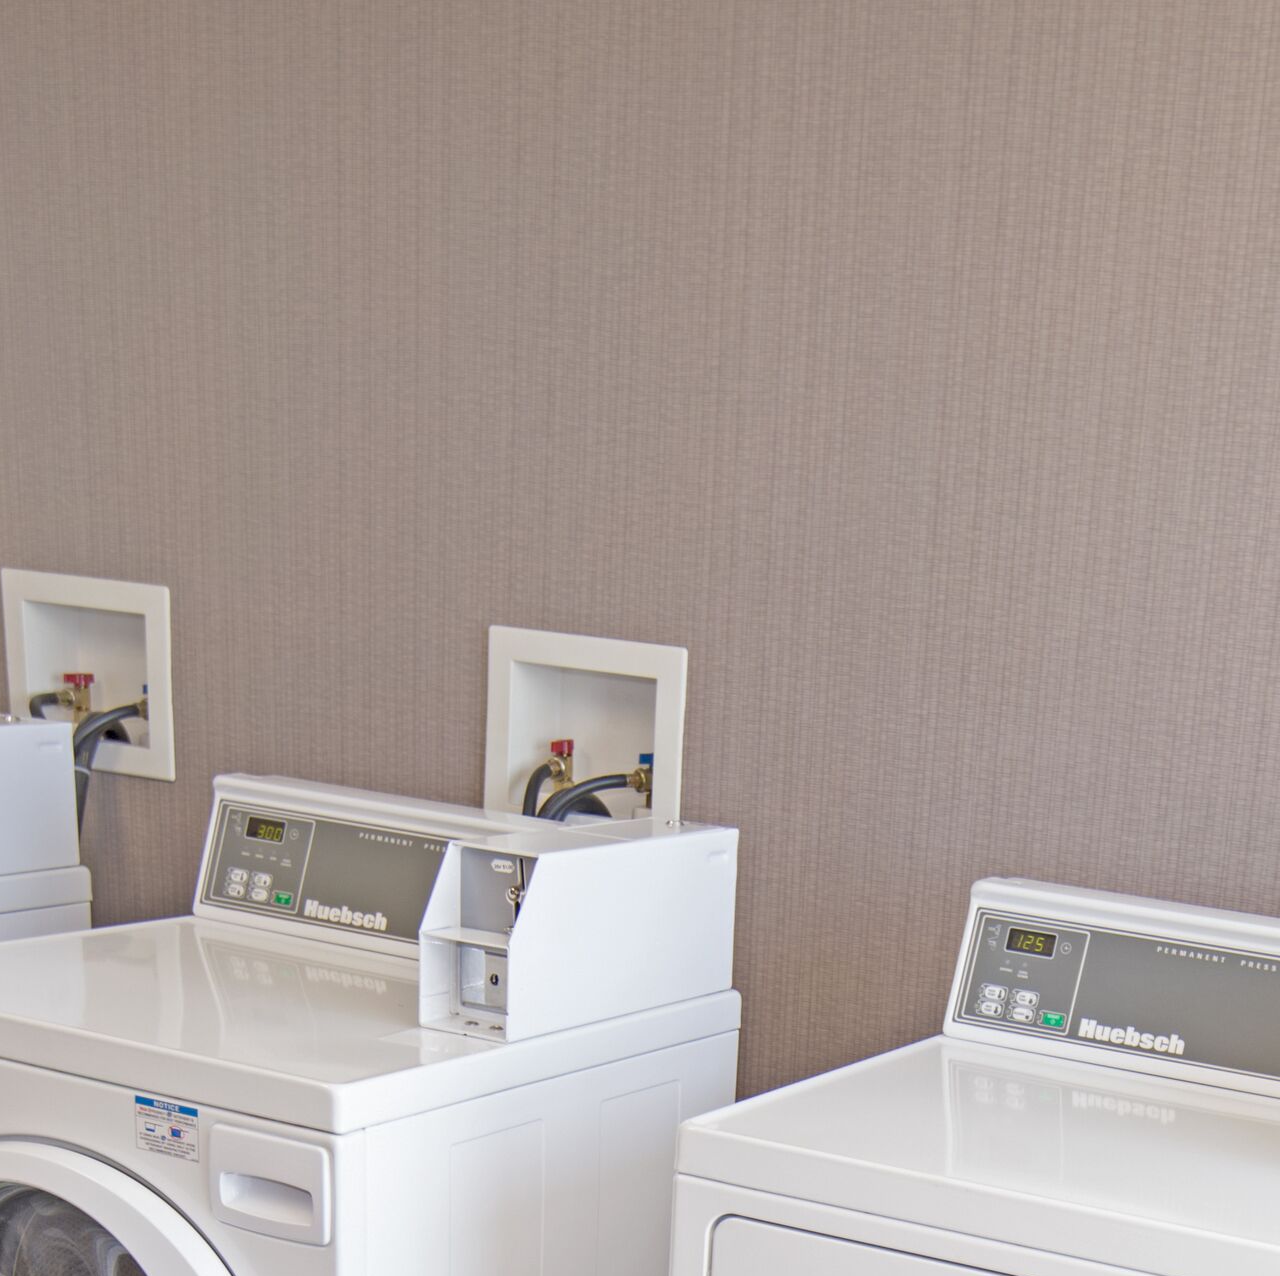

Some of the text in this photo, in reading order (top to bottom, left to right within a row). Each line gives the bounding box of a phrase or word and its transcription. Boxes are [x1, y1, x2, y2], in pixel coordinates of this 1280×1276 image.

[257, 824, 283, 842] 300
[359, 832, 414, 847] PERMANENT
[303, 899, 388, 931] Huebsch
[1017, 934, 1045, 952] 125
[1156, 945, 1226, 964] PERMANENT
[1240, 959, 1278, 973] PRESS
[1078, 1018, 1185, 1055] Huebsch
